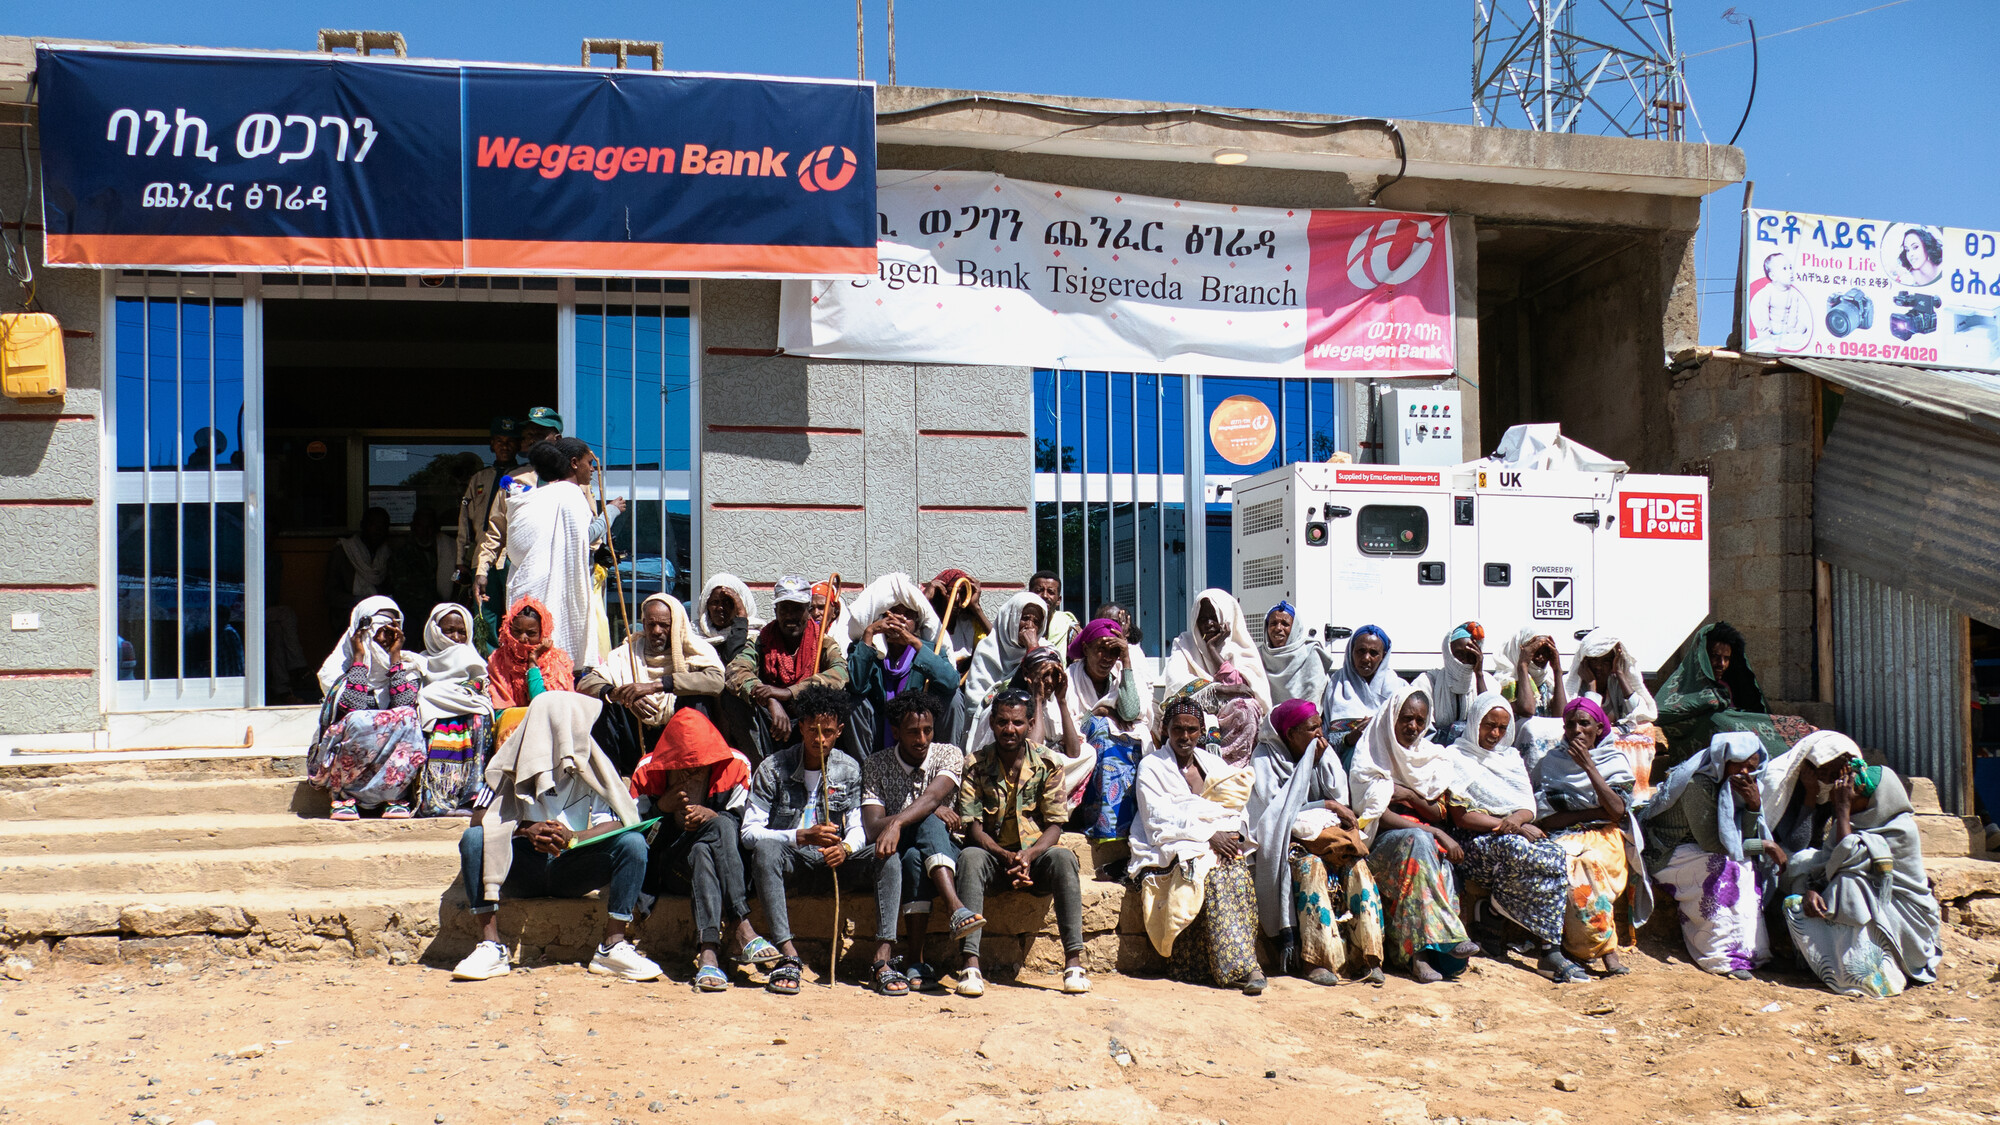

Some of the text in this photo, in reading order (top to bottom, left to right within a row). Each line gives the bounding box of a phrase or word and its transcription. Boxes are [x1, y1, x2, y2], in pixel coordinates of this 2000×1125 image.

[107, 108, 378, 164] ባንኪ ወጋገን
[477, 136, 789, 181] Wegagen Bank
[142, 182, 327, 211] ጨንፈር ፅገሬዳ
[919, 205, 1023, 242] ወጋገን
[1044, 216, 1164, 253] ጨንፈር
[1185, 224, 1276, 259] ፅገሬዳ
[1757, 215, 1876, 251] ፎቶ ላይፍ
[1965, 232, 1996, 259] ፀጋ
[1802, 252, 1877, 272] Photo Life
[956, 259, 1031, 291] Bank
[1045, 265, 1184, 303] Tsigereda
[1199, 275, 1298, 306] Branch
[1368, 322, 1411, 340] ወጋገን
[1312, 343, 1443, 362] Wegagen Bank
[1839, 341, 1938, 362] 0942-674020
[1338, 472, 1362, 482] Supplied
[1362, 473, 1370, 482] by
[1370, 473, 1382, 481] Emu
[1383, 474, 1404, 482] General
[1404, 475, 1427, 483] Importer
[1499, 471, 1522, 488] UK
[1531, 565, 1573, 574] POWERED BY
[1536, 600, 1570, 608] LISTER
[1536, 608, 1570, 616] PETTER
